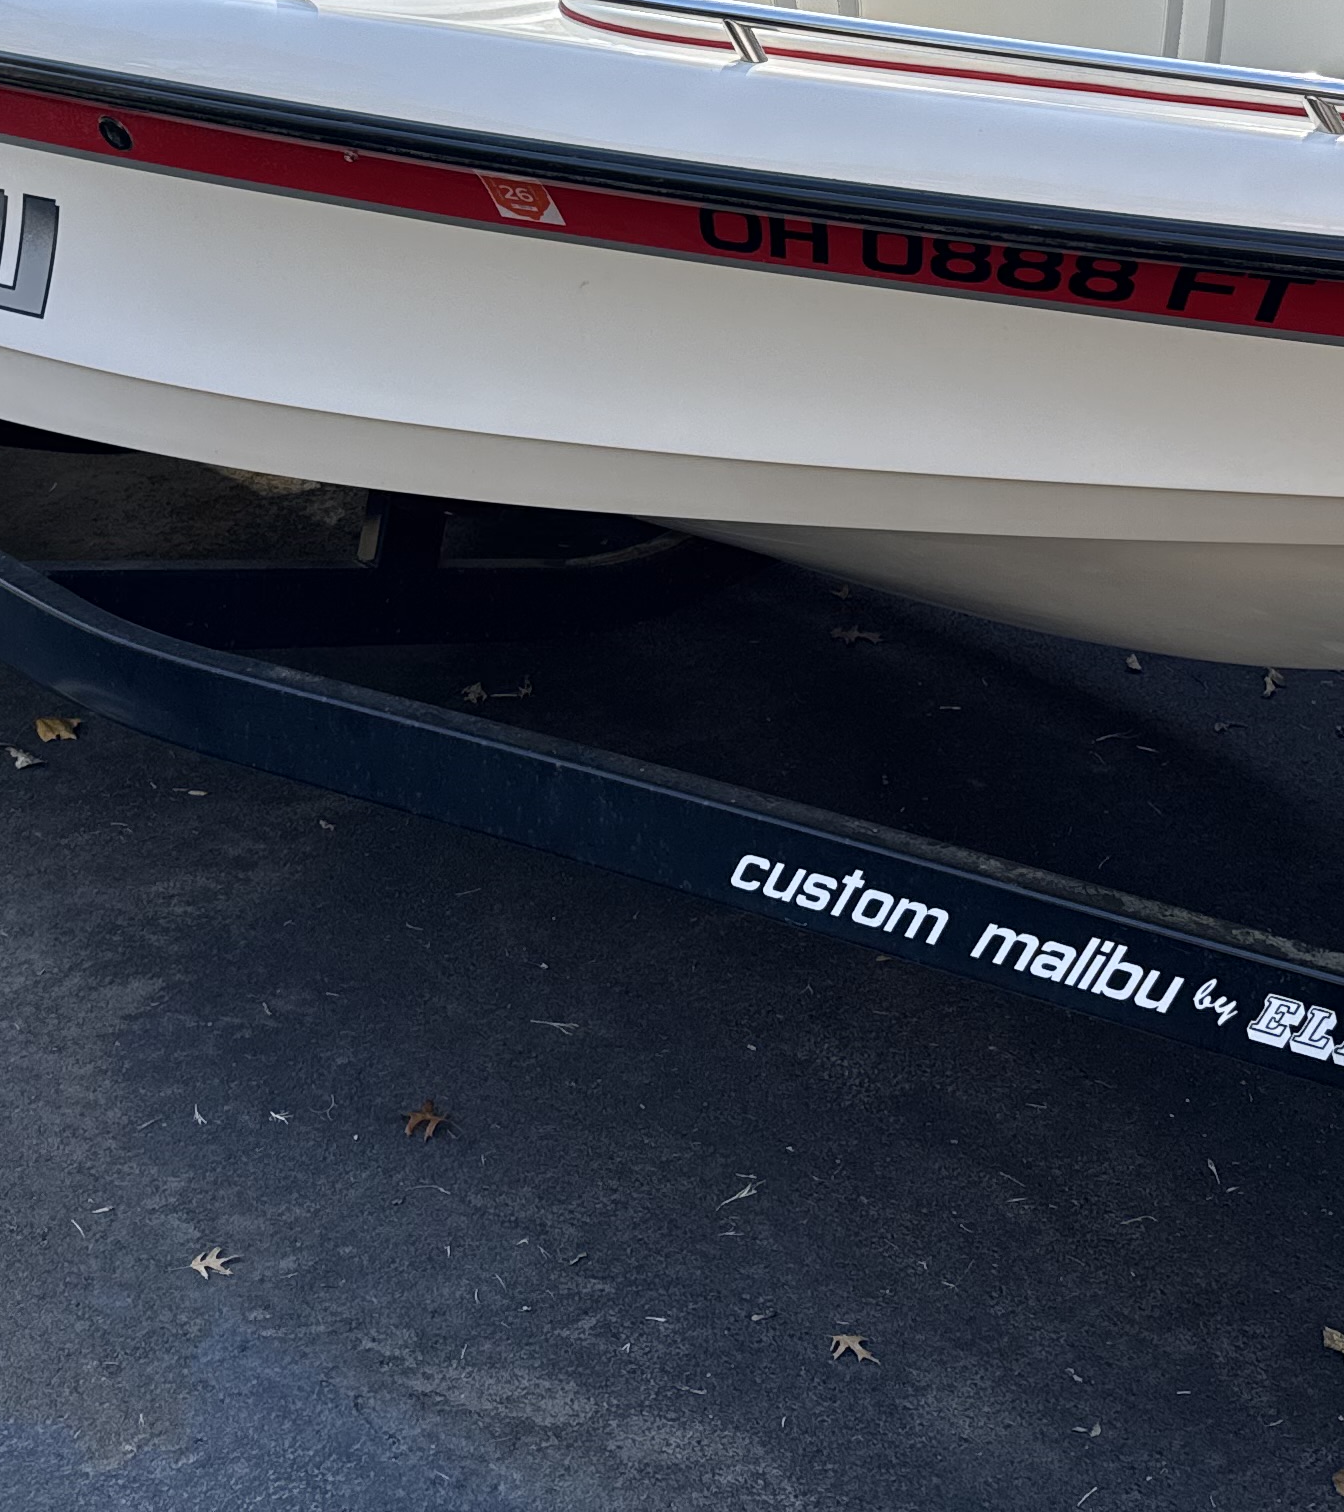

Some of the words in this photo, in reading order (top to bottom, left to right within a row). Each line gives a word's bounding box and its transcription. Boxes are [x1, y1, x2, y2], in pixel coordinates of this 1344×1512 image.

[498, 184, 534, 203] 26
[699, 206, 829, 265] OH
[862, 226, 1138, 302] 0888
[1166, 264, 1318, 324] FT
[729, 853, 950, 946] custom
[969, 922, 1185, 1014] malibu
[1192, 977, 1239, 1026] by
